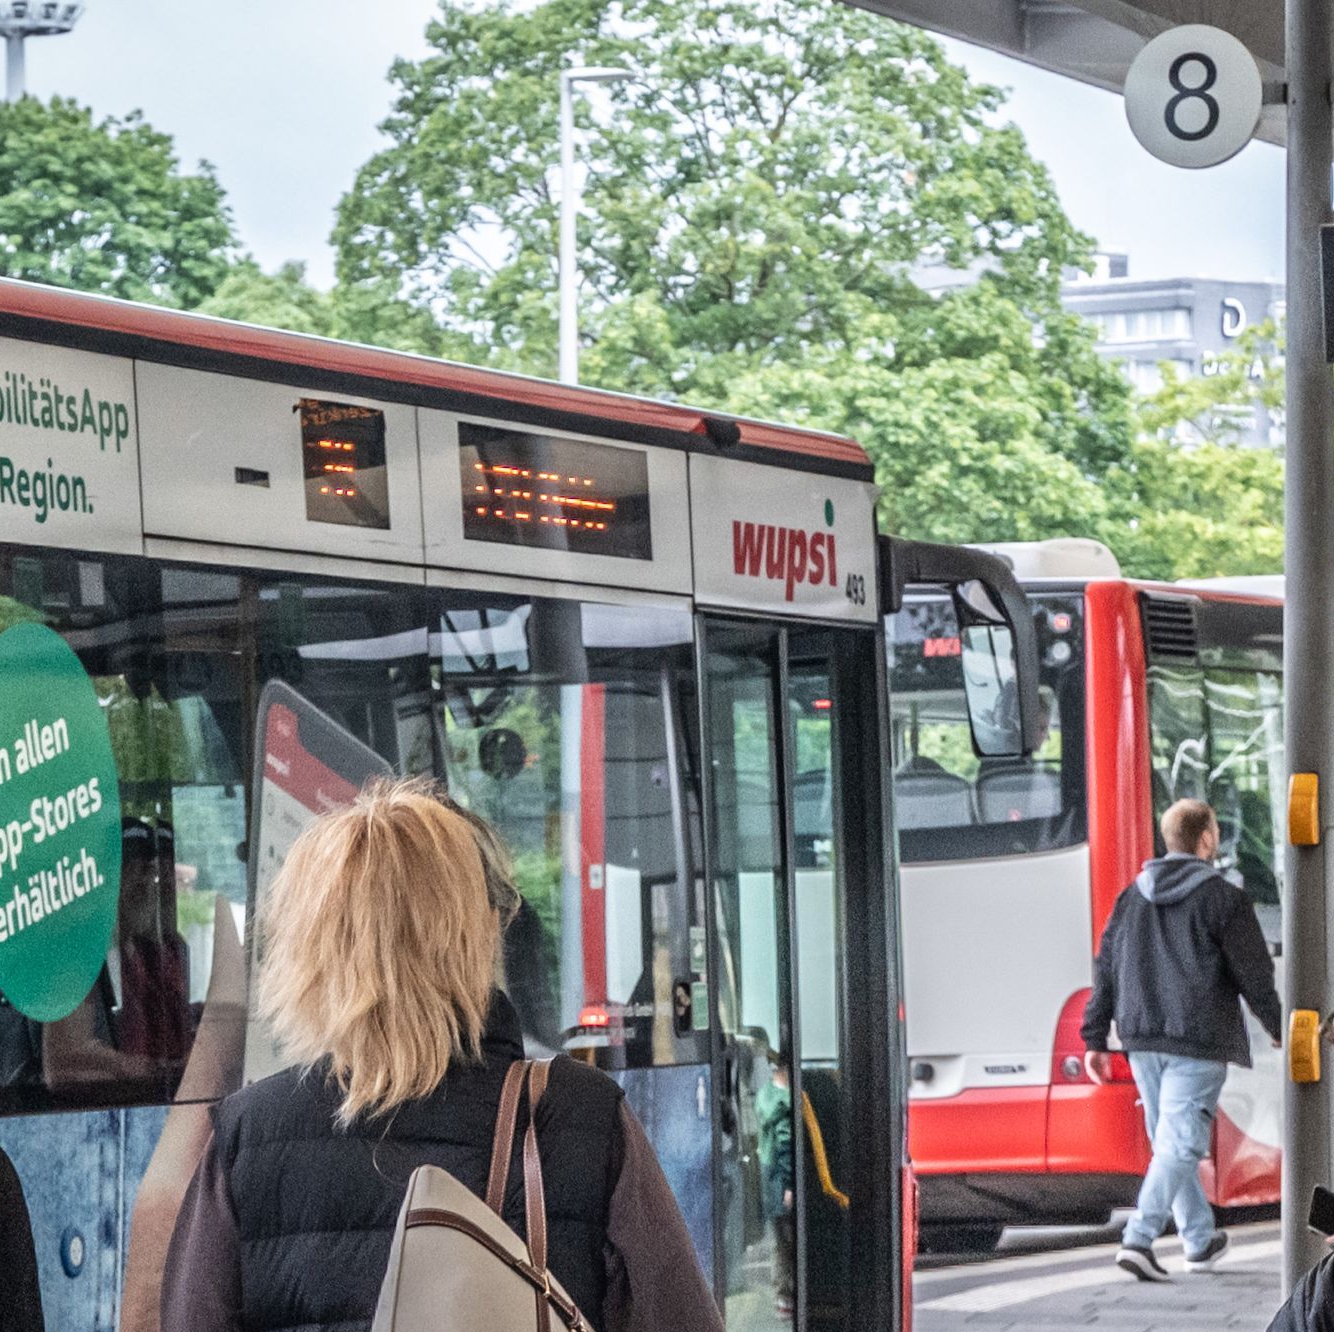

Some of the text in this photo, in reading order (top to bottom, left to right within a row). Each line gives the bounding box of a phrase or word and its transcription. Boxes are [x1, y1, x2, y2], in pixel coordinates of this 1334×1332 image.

[1164, 52, 1220, 141] 8
[0, 457, 94, 524] Region.
[732, 499, 837, 601] wupsi
[846, 573, 865, 606] 493
[14, 717, 70, 774] allen
